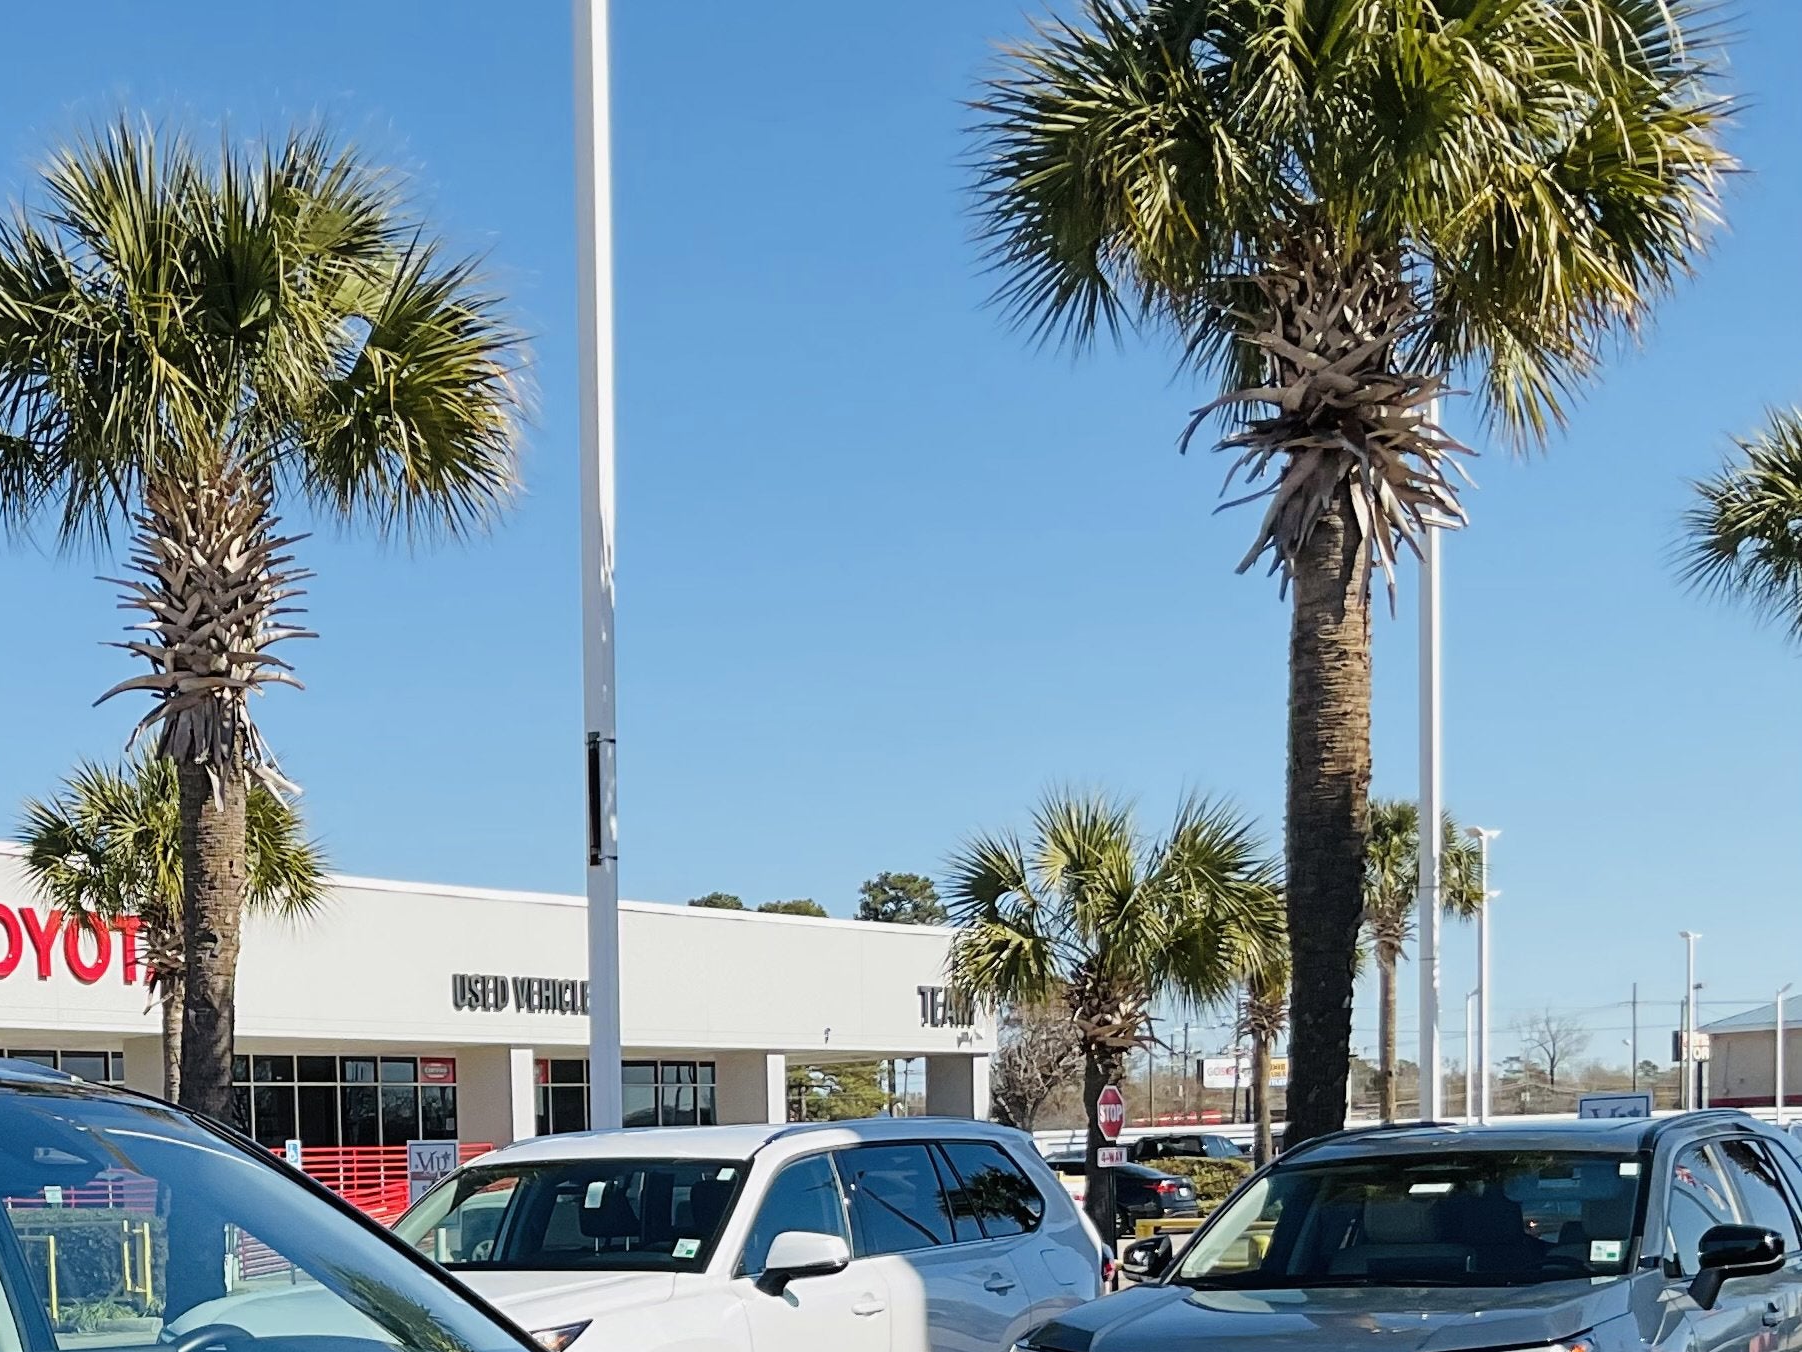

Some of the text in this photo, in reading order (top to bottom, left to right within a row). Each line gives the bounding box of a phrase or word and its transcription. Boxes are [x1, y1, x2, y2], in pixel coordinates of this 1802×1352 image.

[452, 974, 509, 1012] USED
[1099, 1104, 1123, 1123] STOP
[1101, 1151, 1123, 1163] 4-WAY
